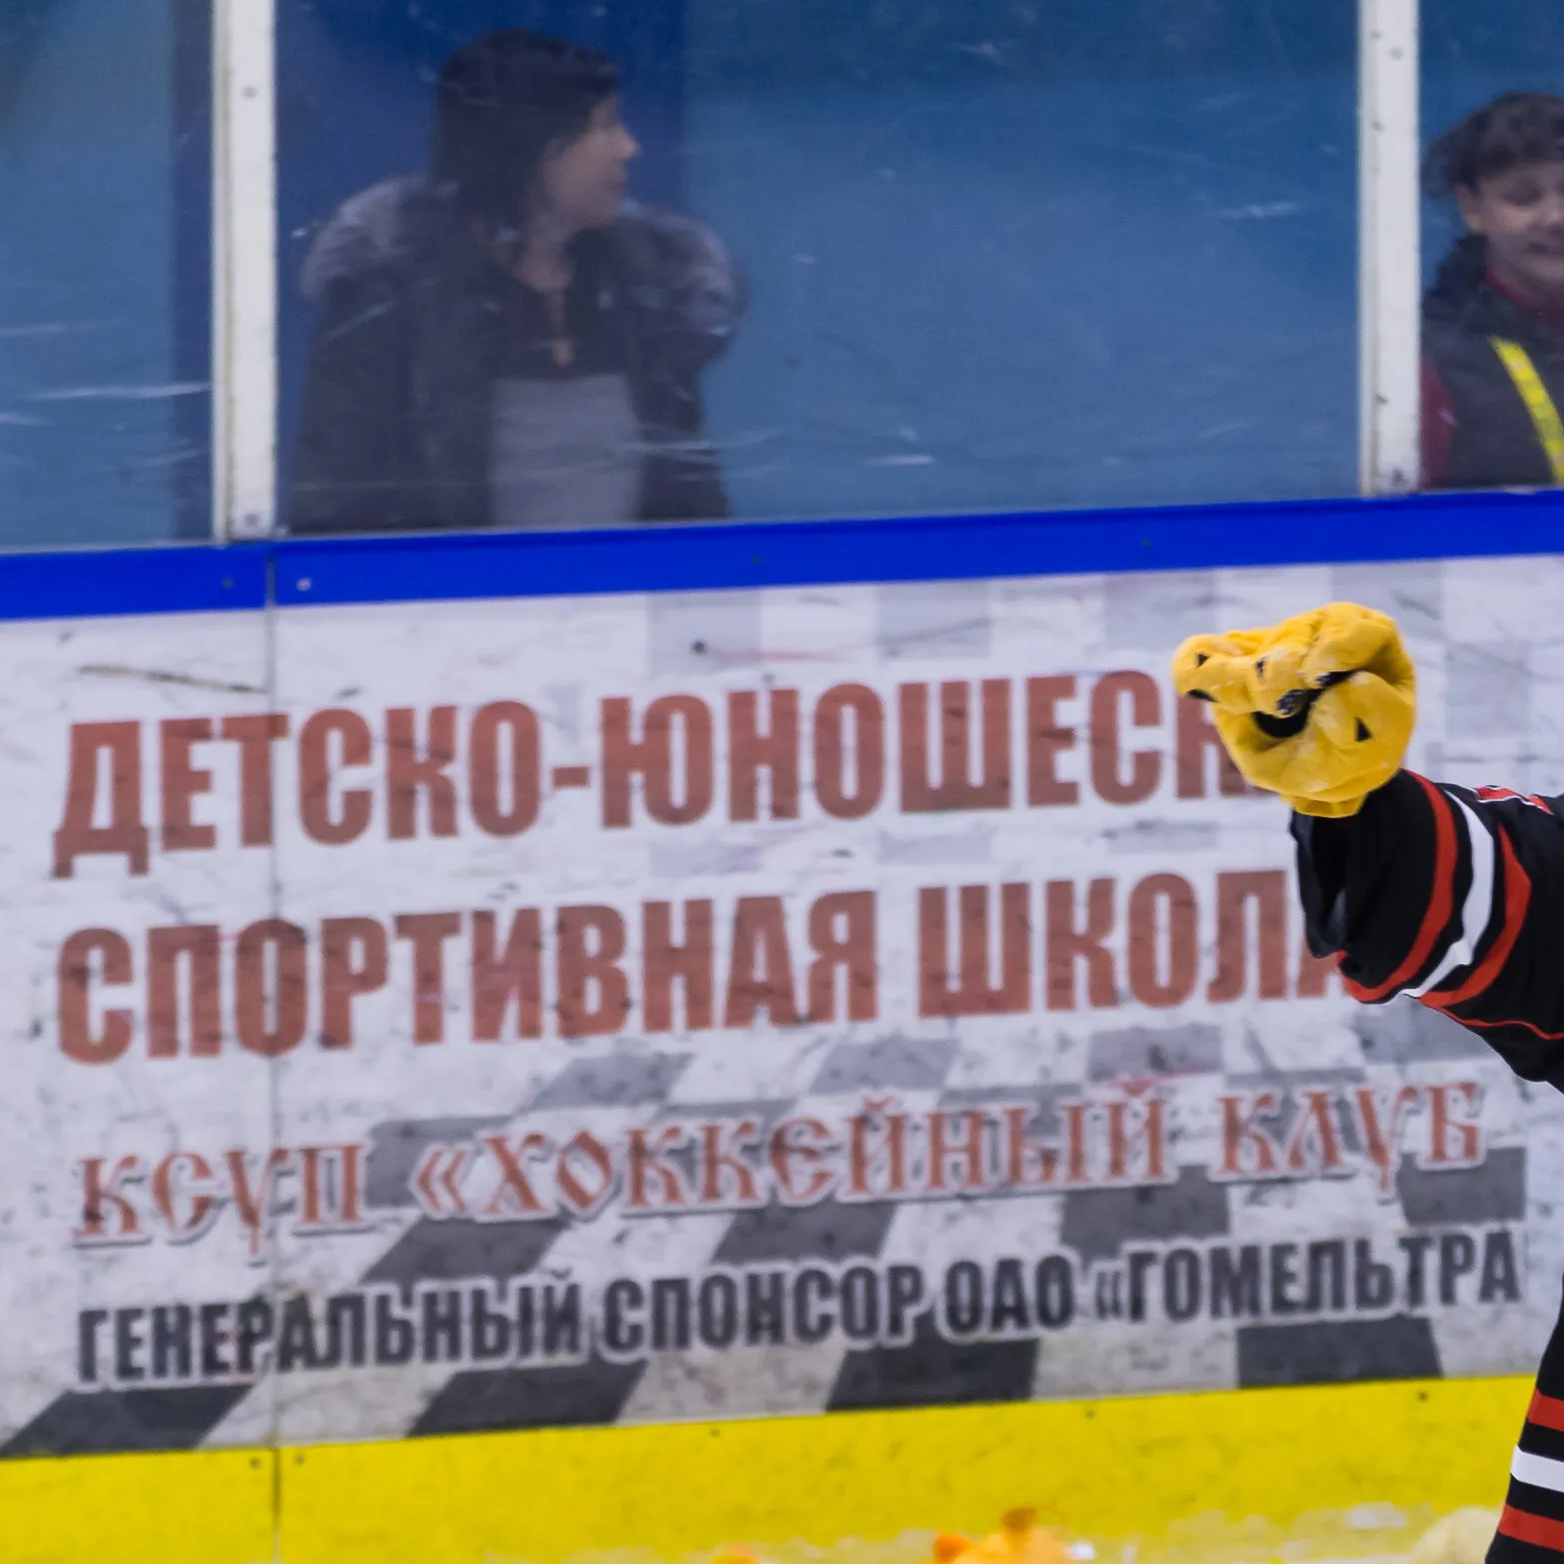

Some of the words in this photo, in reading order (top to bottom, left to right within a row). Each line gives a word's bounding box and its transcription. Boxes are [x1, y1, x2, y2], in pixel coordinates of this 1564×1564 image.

[53, 669, 1281, 878] ДЕТСКО-ЮНОШЕСК
[57, 890, 877, 1065] СПОРТИВНАЯ
[72, 1143, 365, 1255] КСУП
[414, 1081, 1169, 1215] «ХОККЕЙНЫЙ
[1216, 1083, 1481, 1193] КЛУБ
[78, 1268, 582, 1383] ГЕНЕРАЛЬНЫЙ
[603, 1264, 923, 1352] СПОНСОР
[944, 1254, 1075, 1335] ОАО
[1095, 1230, 1521, 1323] «ГОМЕЛЬТРА
